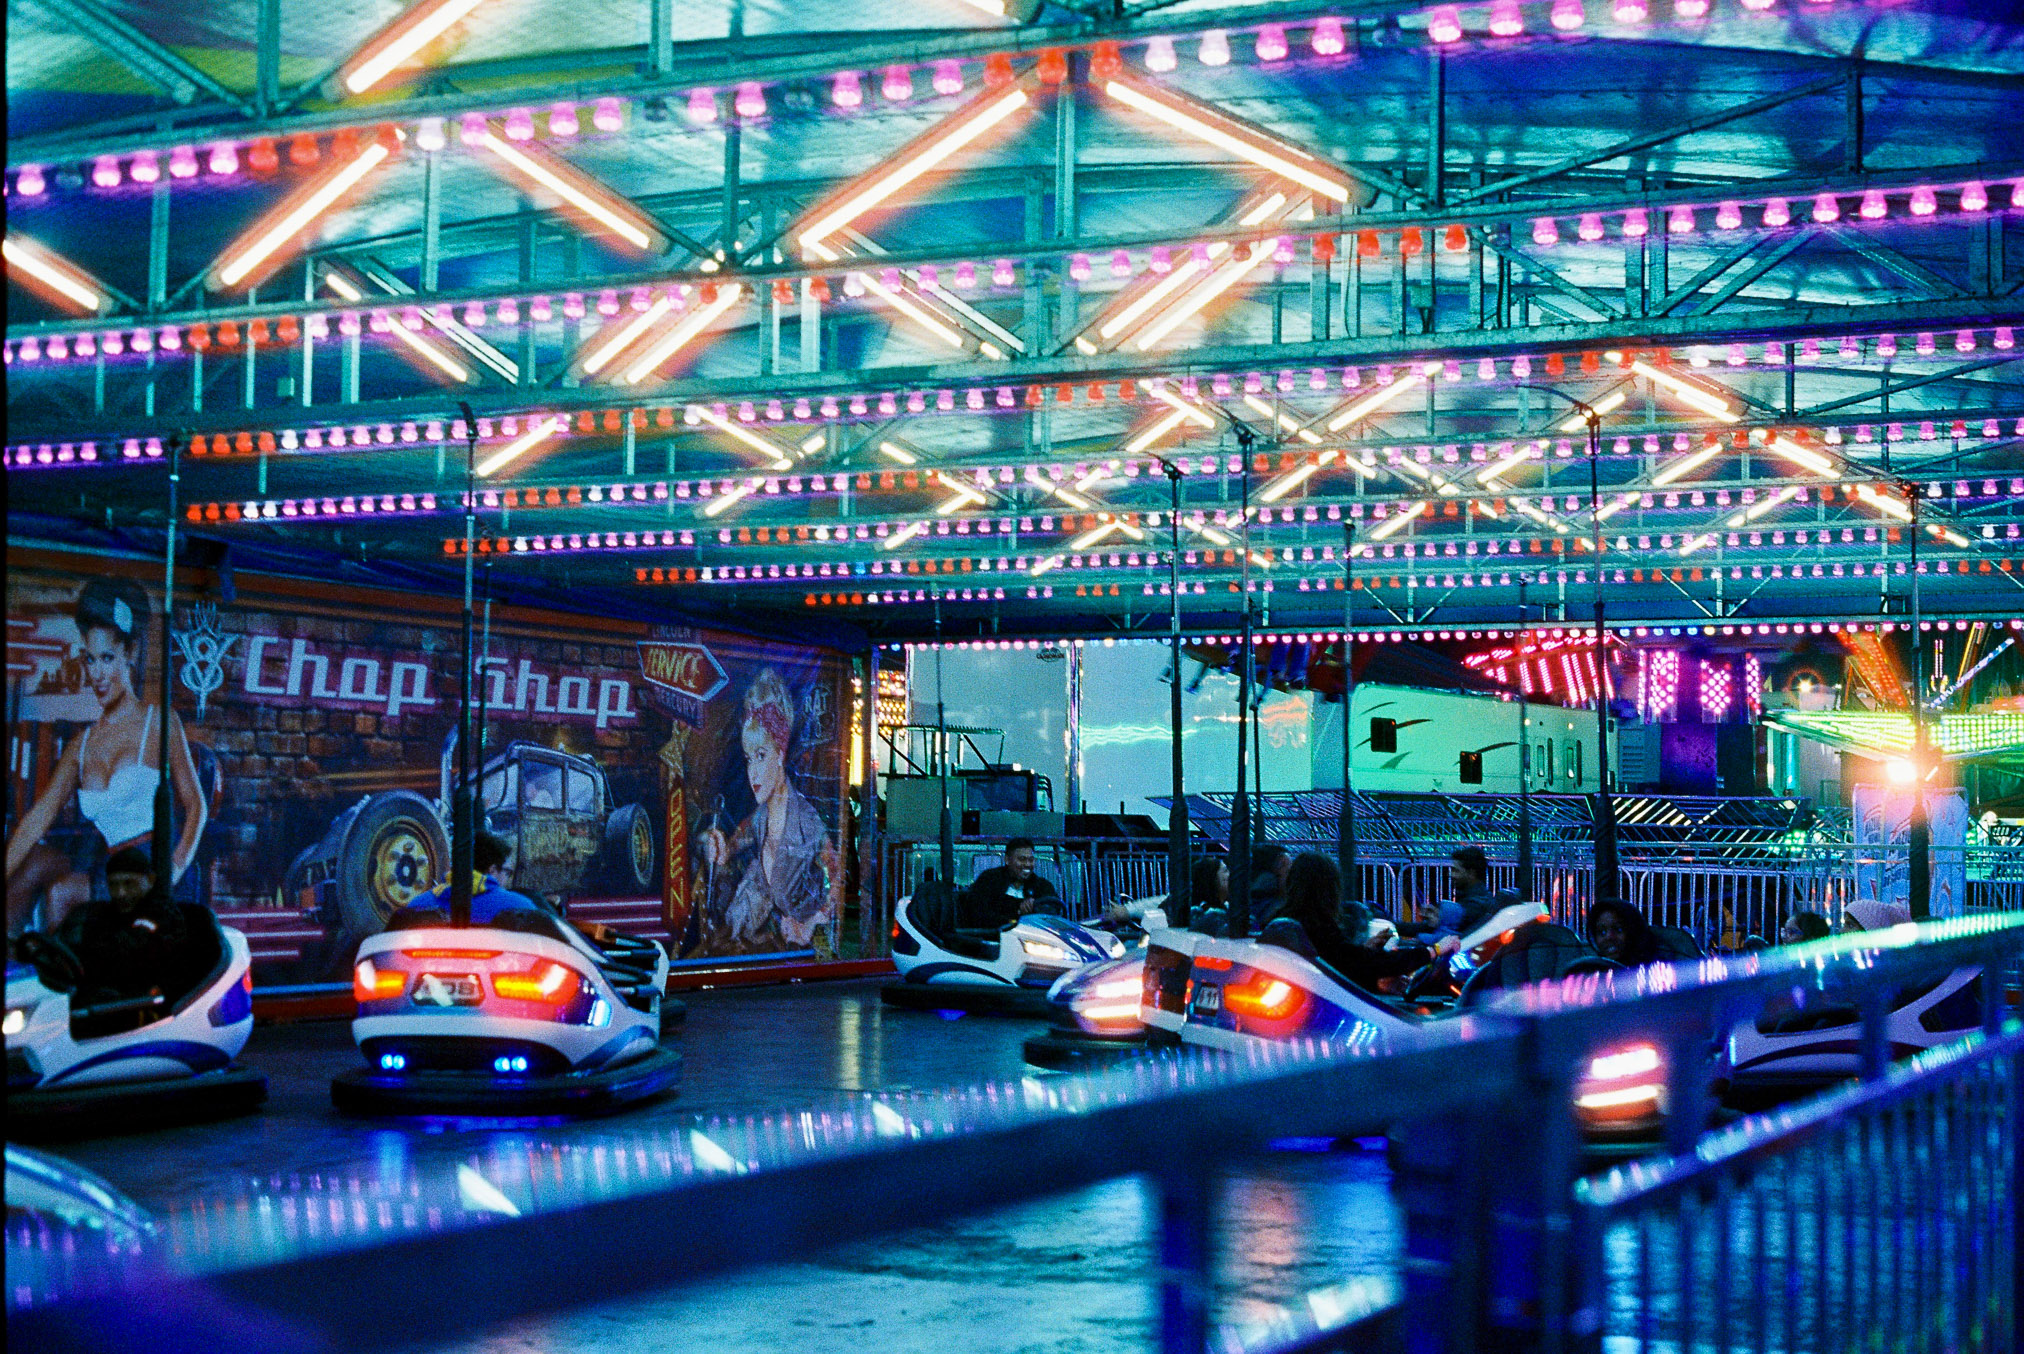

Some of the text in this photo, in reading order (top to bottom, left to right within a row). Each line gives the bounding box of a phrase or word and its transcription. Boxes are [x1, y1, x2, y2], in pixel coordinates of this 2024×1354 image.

[244, 635, 636, 729] Chop Shop
[645, 648, 704, 689] SERVICE
[669, 785, 686, 921] OPEN
